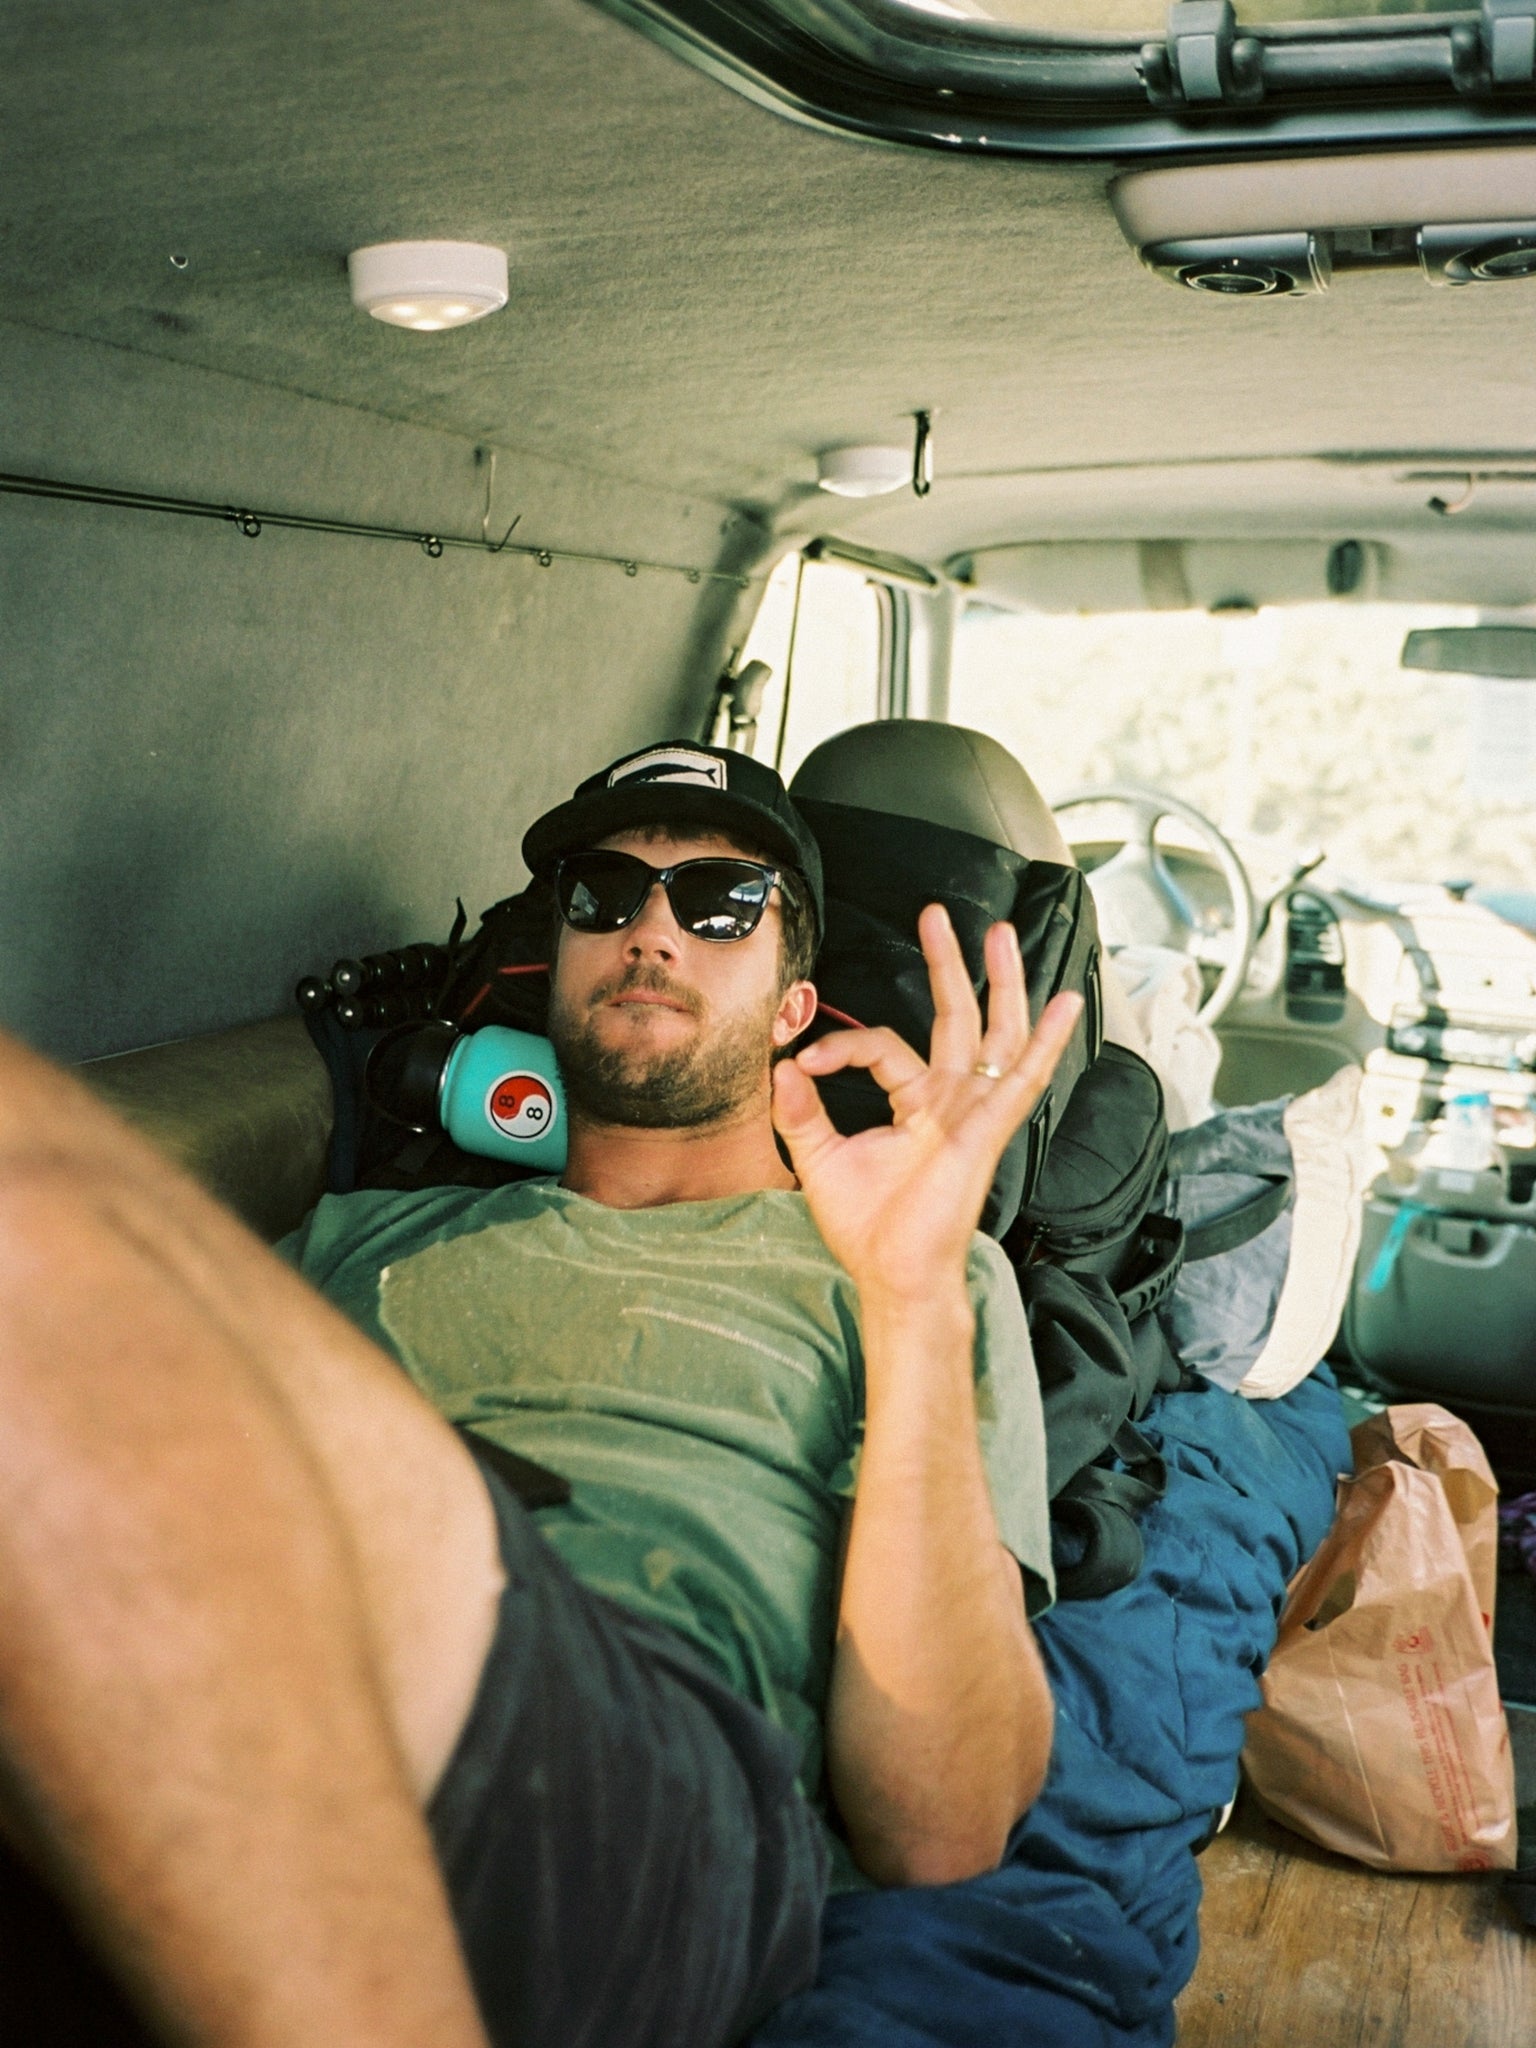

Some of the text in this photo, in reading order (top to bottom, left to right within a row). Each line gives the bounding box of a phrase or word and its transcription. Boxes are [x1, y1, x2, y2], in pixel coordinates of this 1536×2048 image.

[526, 1107, 543, 1120] 8
[1396, 1663, 1413, 1685] BAG
[1418, 1742, 1434, 1766] THIS
[1427, 1769, 1447, 1810] RECYCLE
